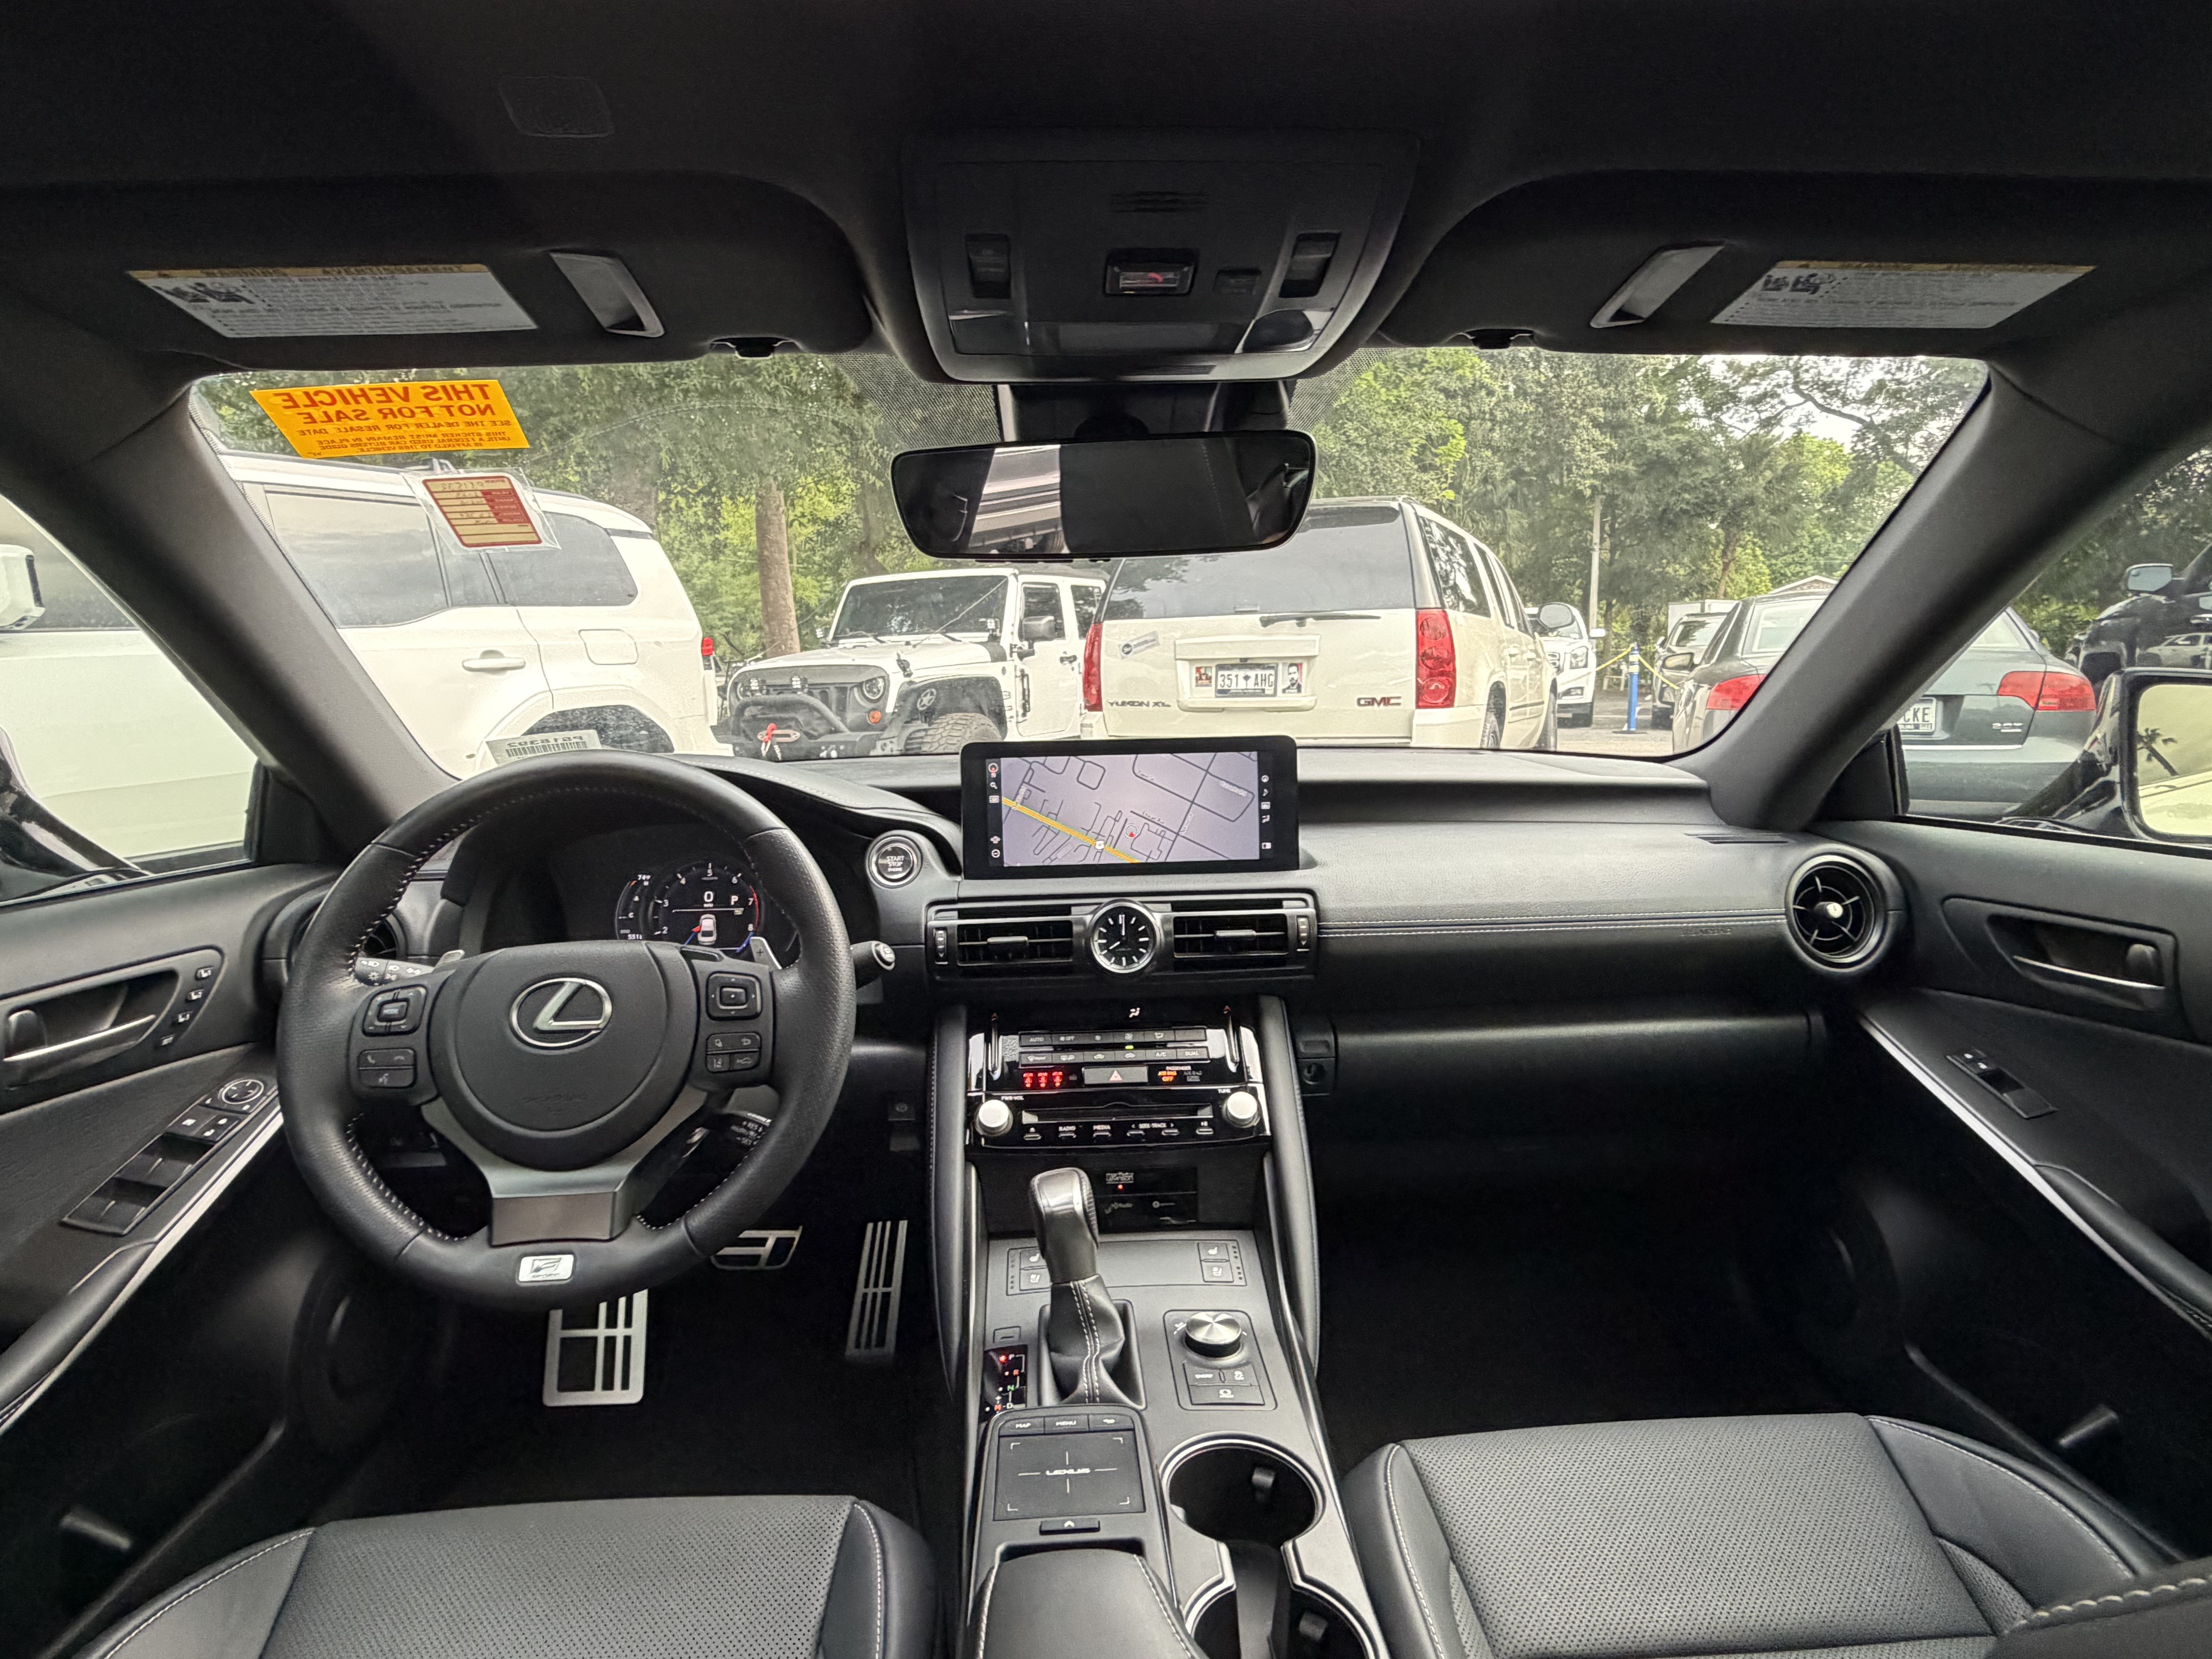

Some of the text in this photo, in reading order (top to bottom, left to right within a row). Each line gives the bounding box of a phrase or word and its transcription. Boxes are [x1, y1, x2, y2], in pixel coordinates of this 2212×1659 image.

[1219, 673, 1274, 688] 351 AHG
[1357, 696, 1401, 707] GMC
[704, 891, 714, 902] 0
[731, 895, 738, 905] P
